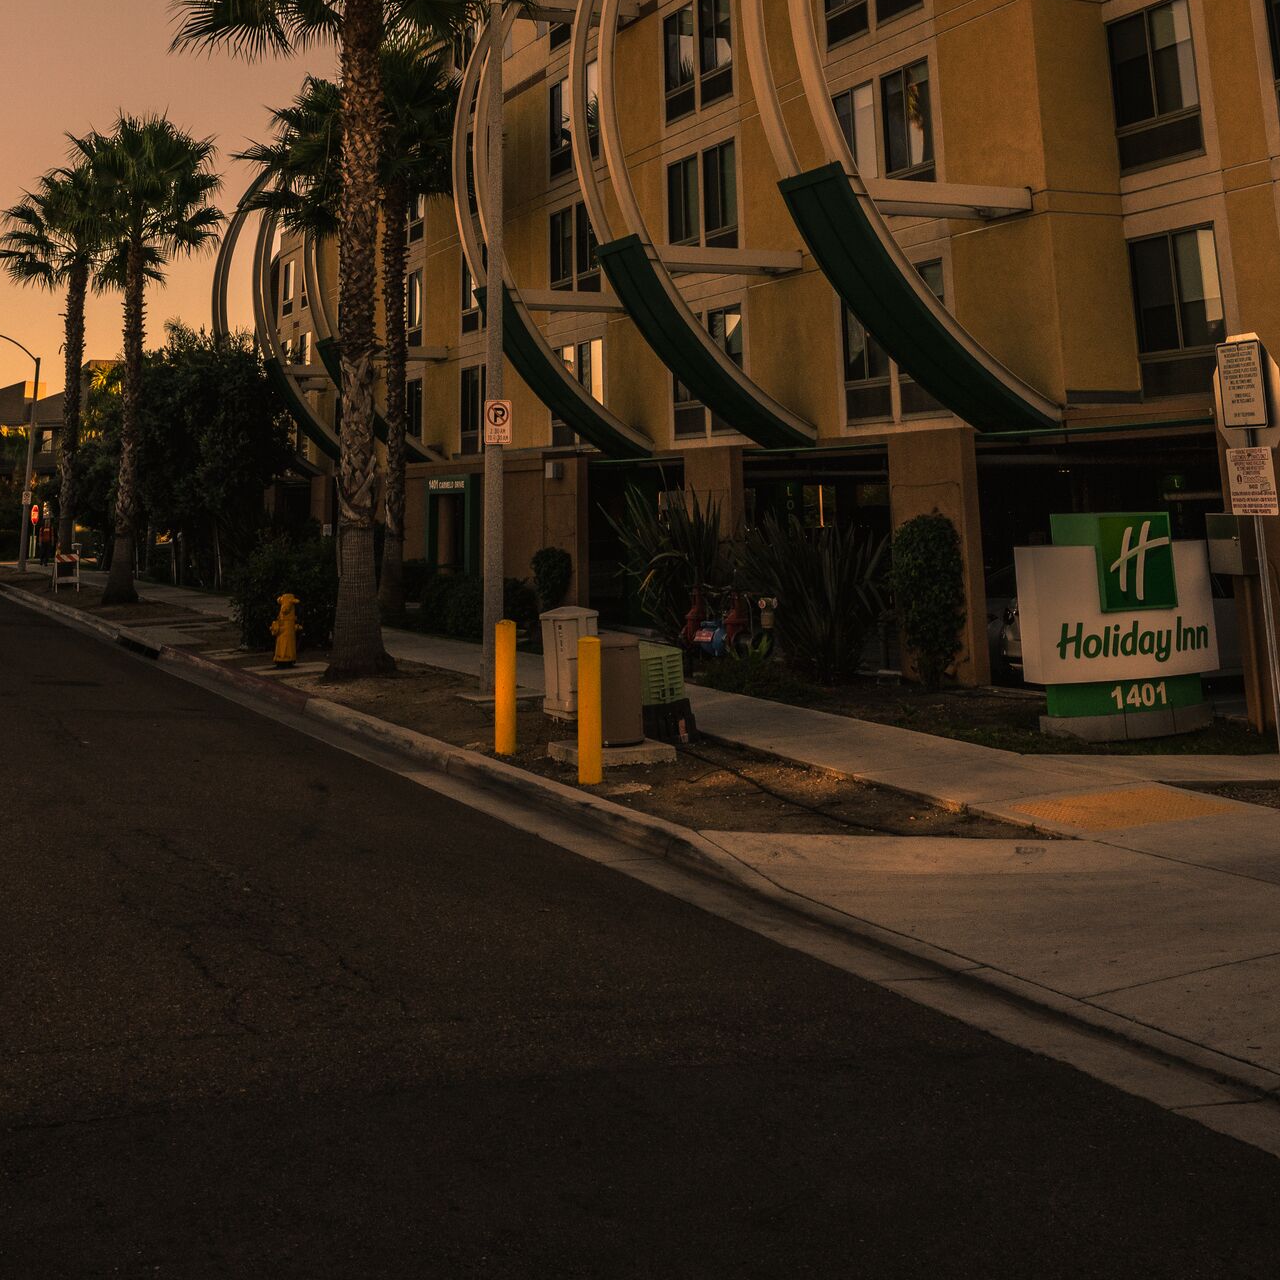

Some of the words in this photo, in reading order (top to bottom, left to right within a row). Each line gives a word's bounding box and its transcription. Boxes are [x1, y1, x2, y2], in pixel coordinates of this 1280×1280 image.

[1056, 620, 1172, 662] Holiday
[1176, 616, 1209, 652] Inn
[1111, 681, 1168, 710] 1401
